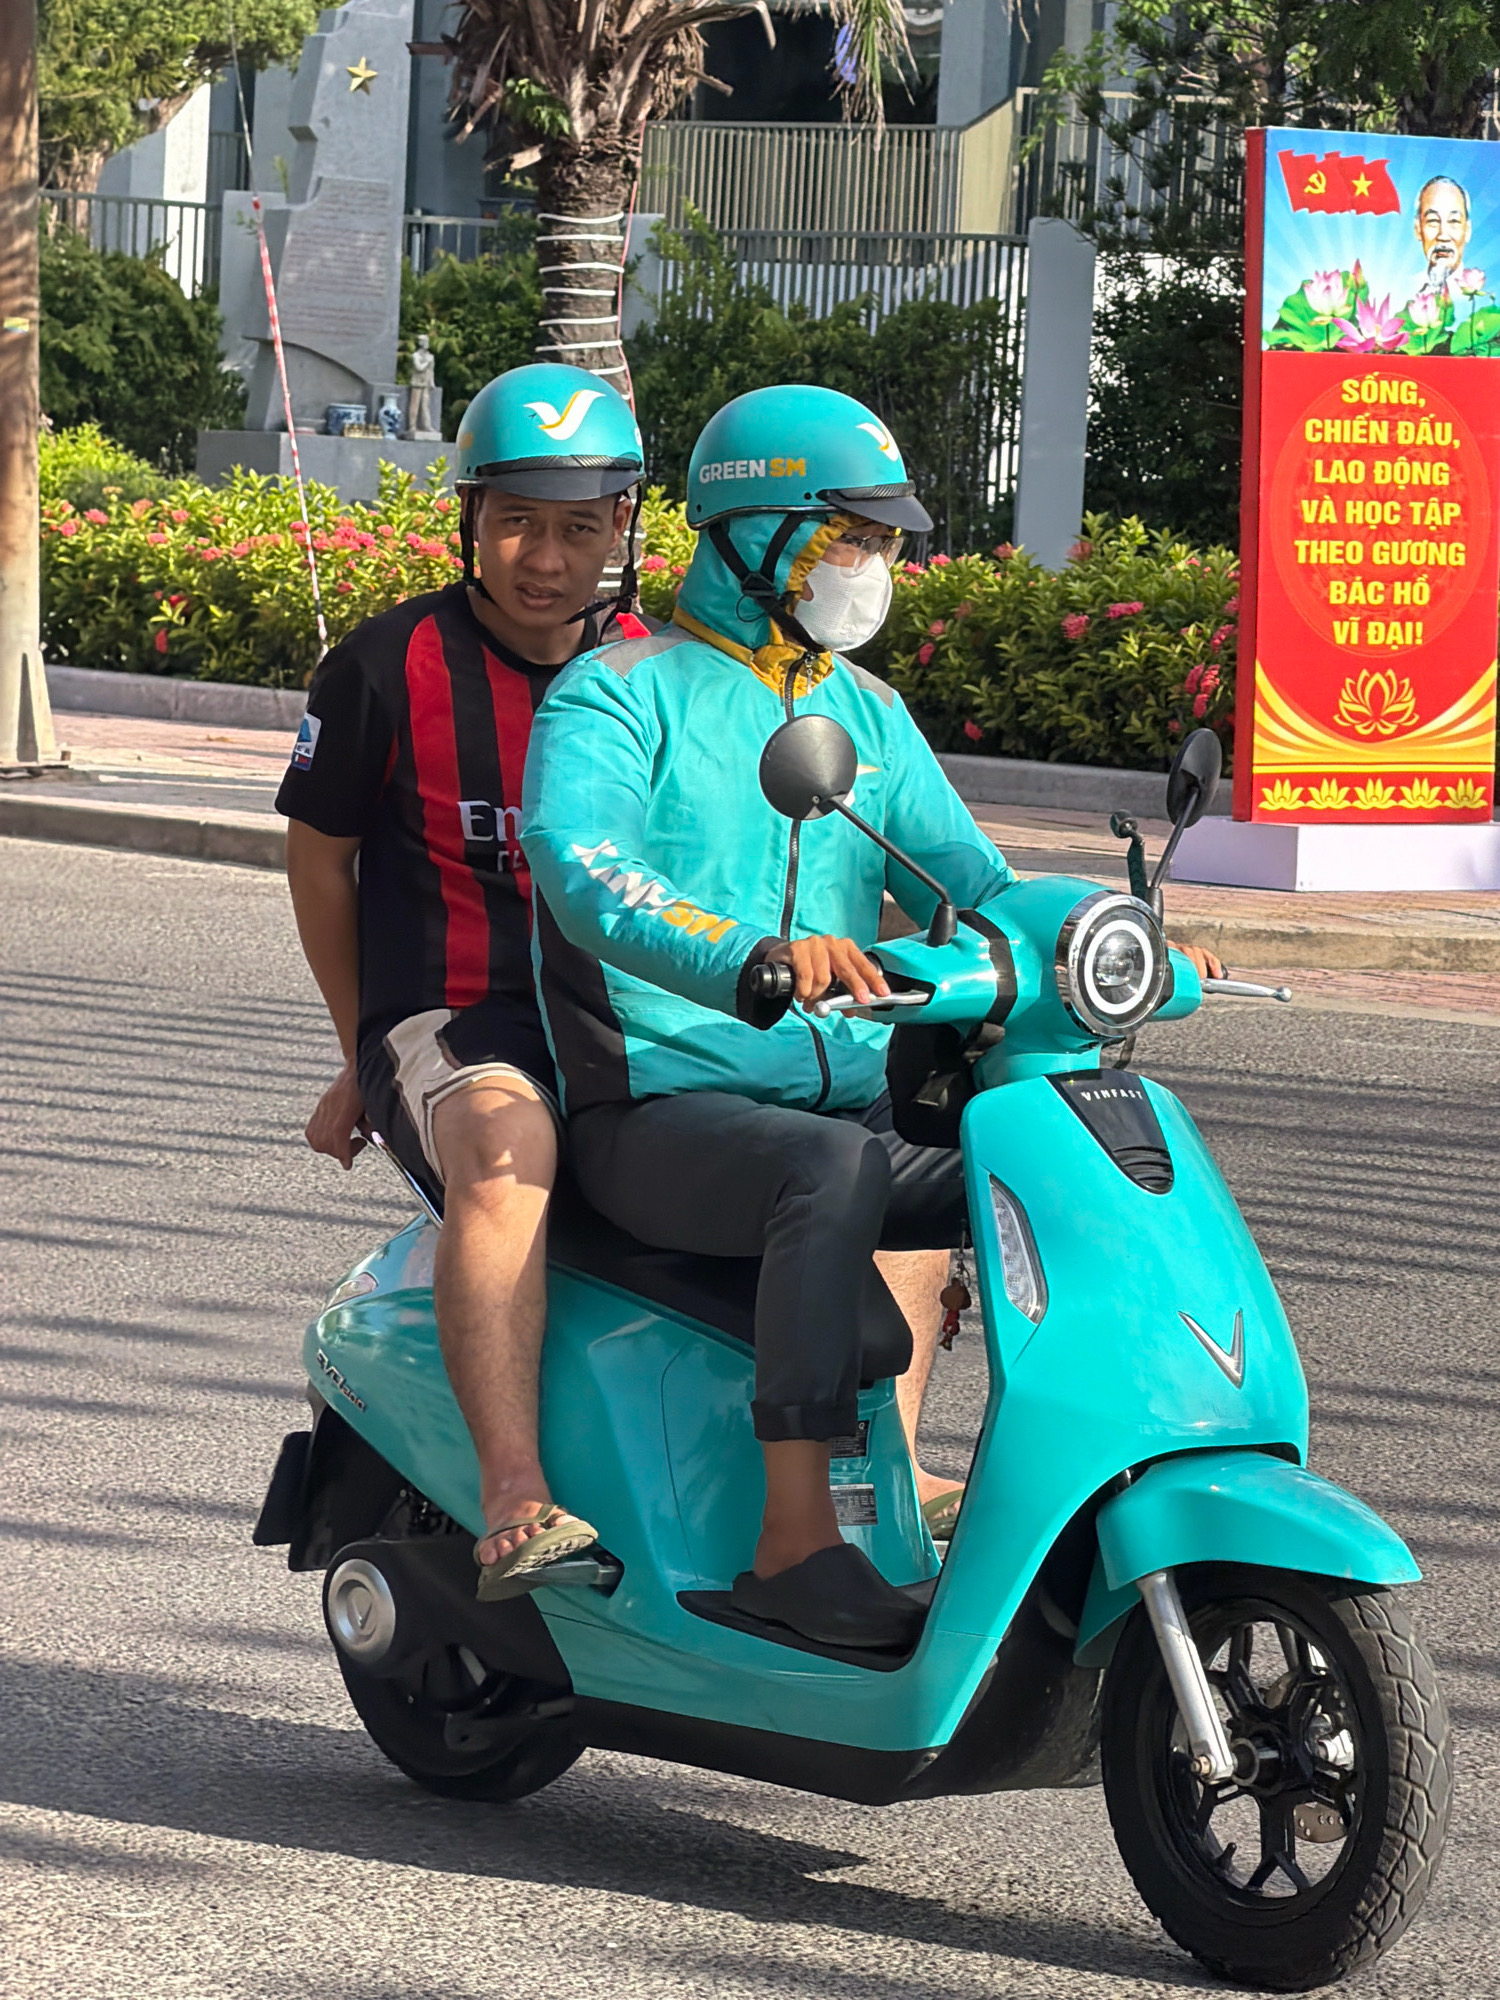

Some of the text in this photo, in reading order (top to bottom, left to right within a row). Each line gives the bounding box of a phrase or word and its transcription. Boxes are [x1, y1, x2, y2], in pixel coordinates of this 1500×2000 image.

[1341, 371, 1426, 408] SỐNG,
[1304, 412, 1461, 449] CHIẾN ĐẤU,
[699, 457, 806, 484] GREEN SM
[1314, 455, 1450, 491] LAO ĐỘNG
[1300, 494, 1461, 531] VÀ HỌC TẬP
[1293, 538, 1466, 566] THEO GƯƠNG
[1329, 573, 1431, 606] BÁC HỒ
[1332, 616, 1424, 651] VĨ ĐẠI!
[1080, 1088, 1143, 1101] VINFAST
